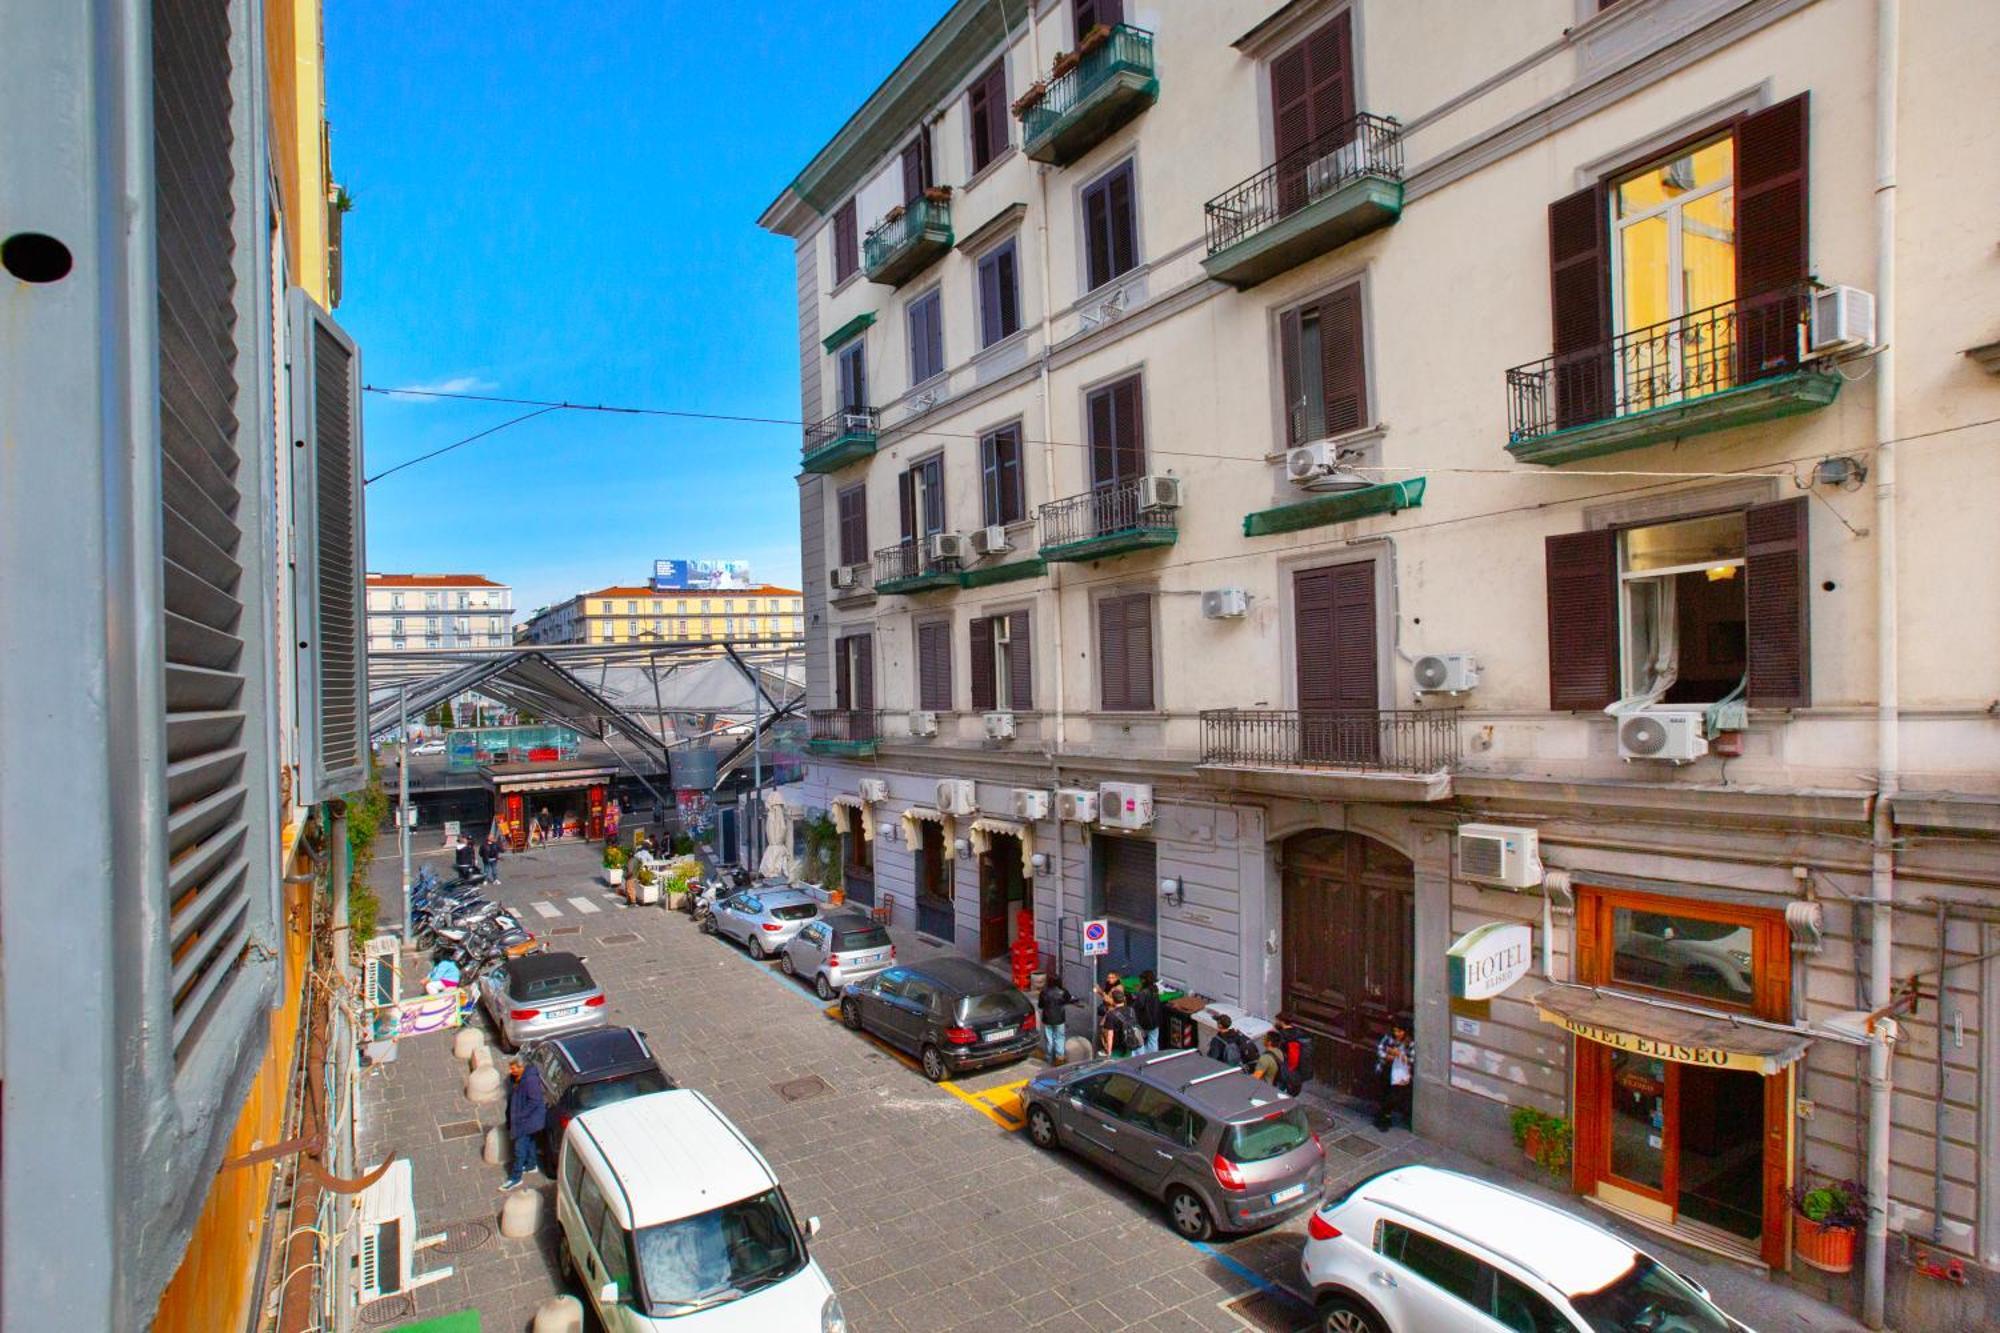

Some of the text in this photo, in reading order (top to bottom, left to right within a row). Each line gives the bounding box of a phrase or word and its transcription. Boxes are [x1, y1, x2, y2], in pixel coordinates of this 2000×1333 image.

[1468, 944, 1528, 985] HOTEL
[1566, 1019, 1729, 1066] HOTEL ELISEO
